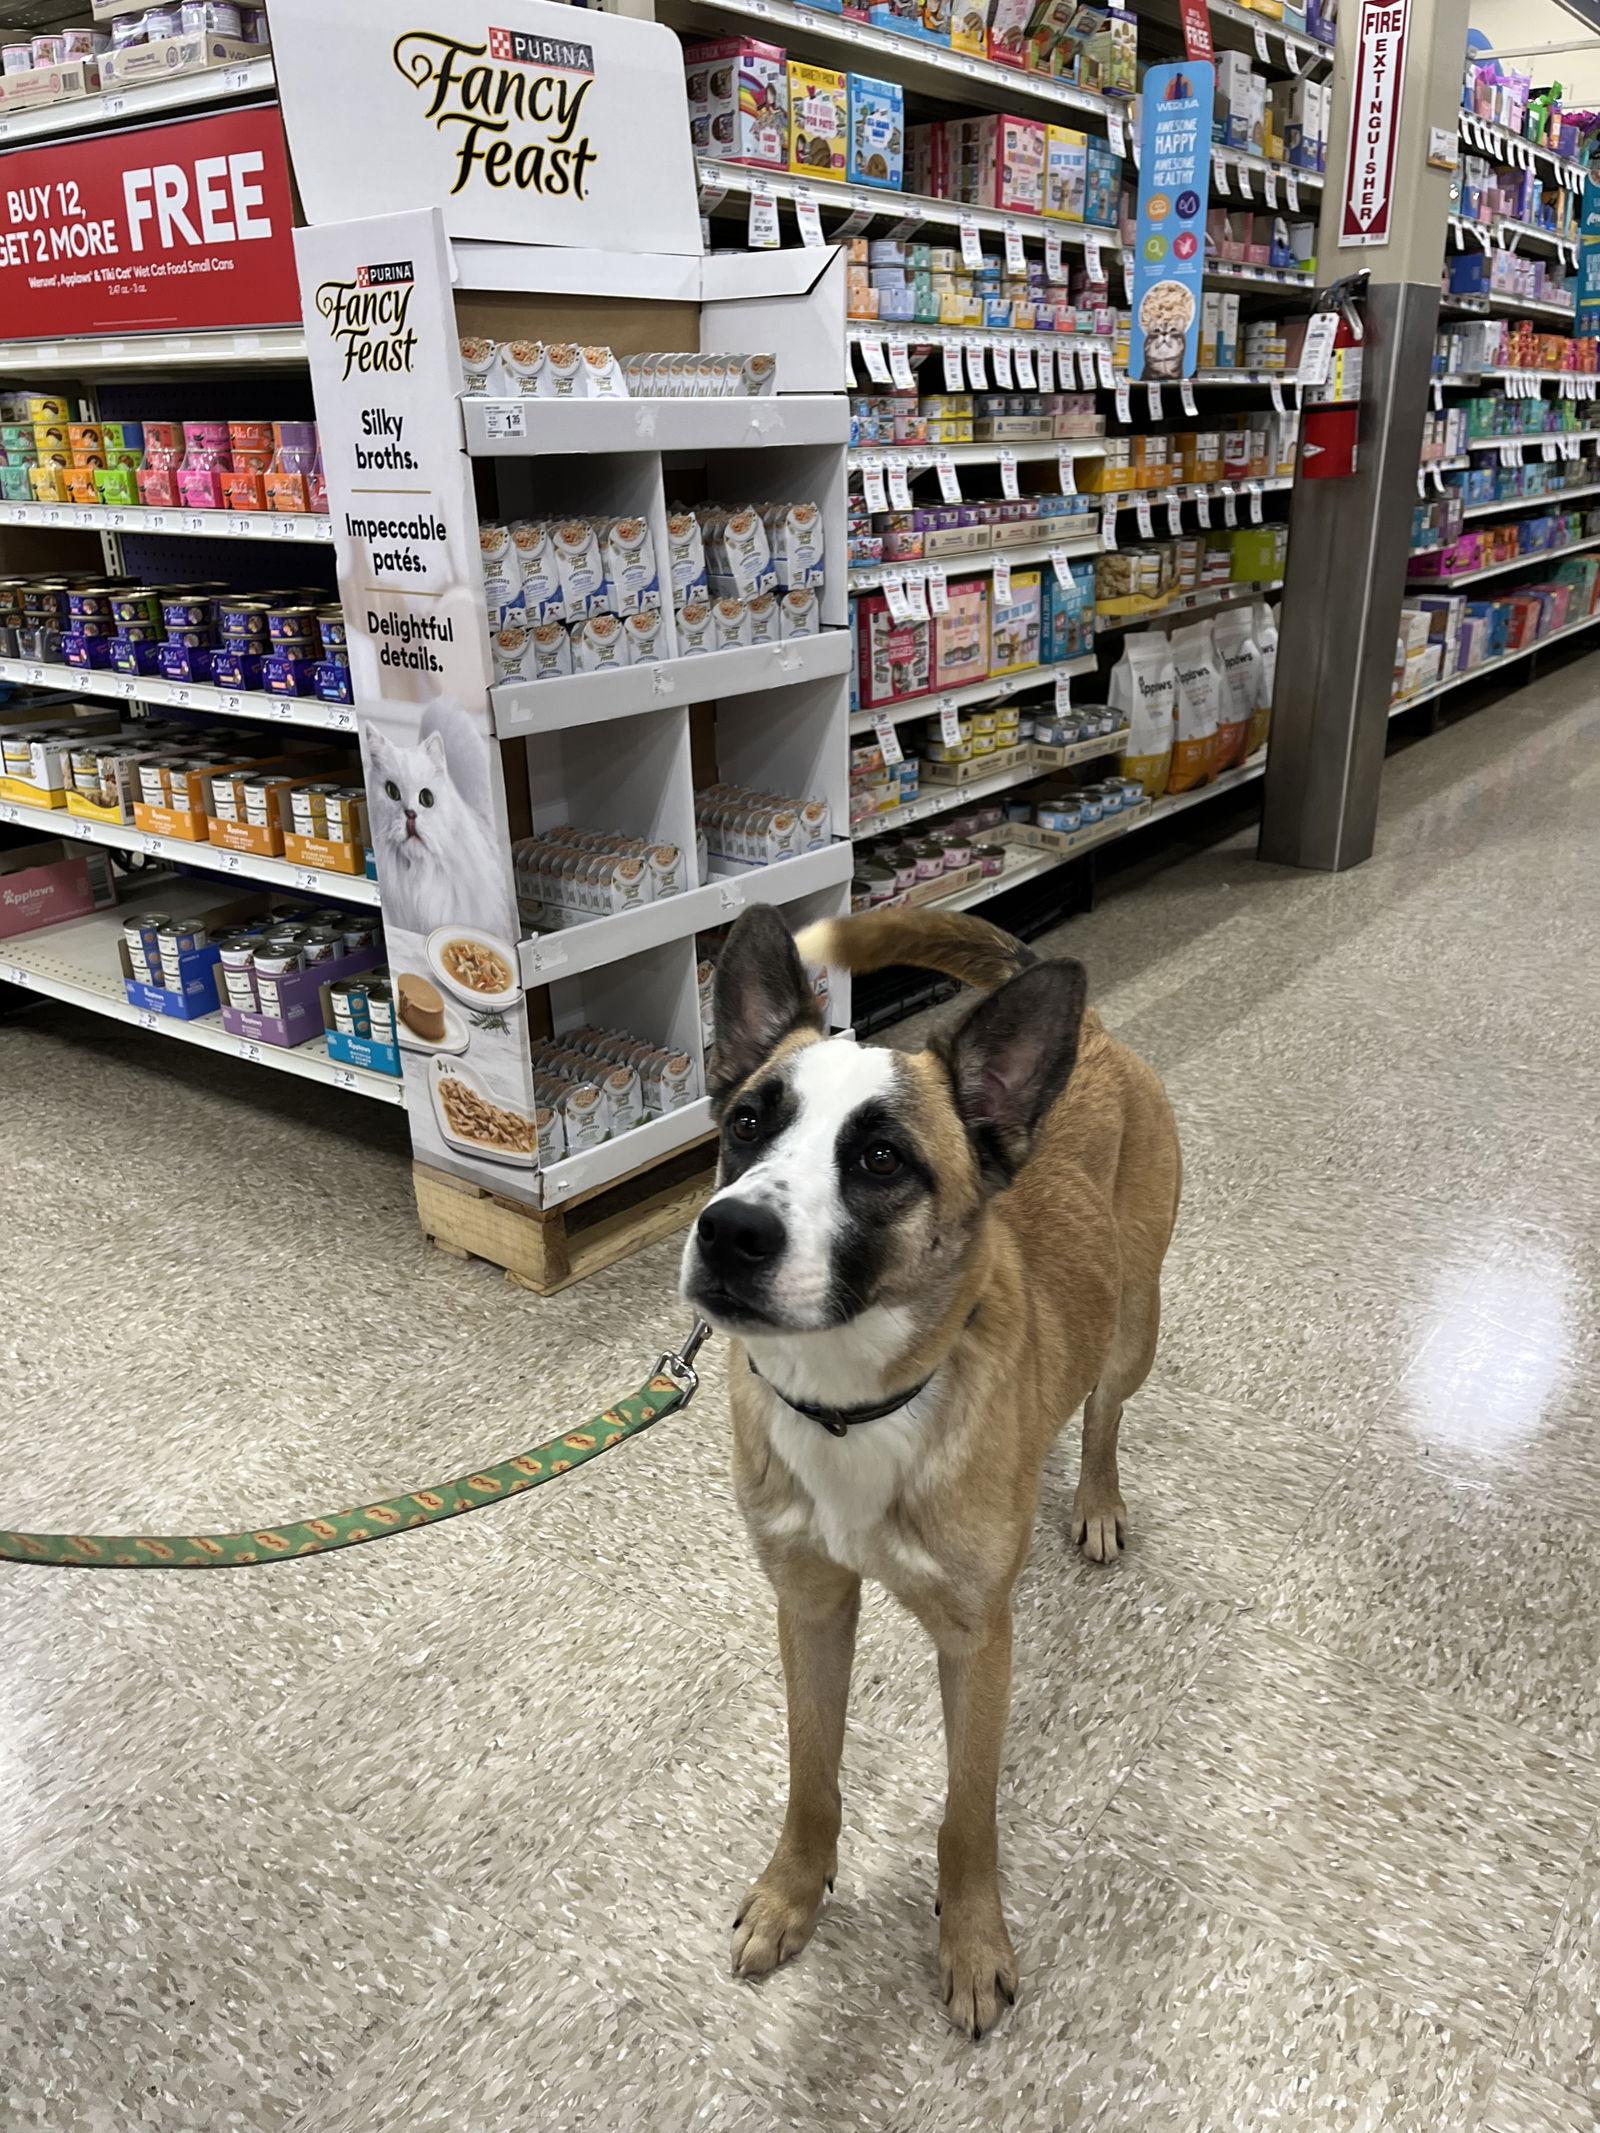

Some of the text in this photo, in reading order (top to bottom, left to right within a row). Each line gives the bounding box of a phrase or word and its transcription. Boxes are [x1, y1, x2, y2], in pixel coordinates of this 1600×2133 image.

[1365, 10, 1402, 35] FIRE
[514, 36, 590, 68] PURINA
[393, 31, 594, 143] Fancy
[1155, 133, 1197, 154] HAPPY
[1360, 39, 1387, 219] EXTINGUISHER
[1153, 170, 1194, 186] HEALTHY
[7, 181, 87, 224] BUY 12,
[122, 150, 273, 253] FREE
[0, 219, 119, 267] GET 2 MORE
[101, 268, 115, 281] Tiki
[133, 265, 150, 278] Wet
[151, 264, 166, 277] Cat
[167, 262, 187, 275] Food
[188, 259, 211, 273] Small
[212, 259, 234, 271] Cans
[370, 265, 412, 281] PURINA
[315, 281, 414, 336] Fancy
[361, 408, 403, 441] Silky
[355, 443, 418, 469] broths.
[345, 513, 447, 543] Impeccable
[373, 547, 427, 575] patés.
[367, 611, 453, 643] Delightful
[380, 643, 443, 673] details.
[3, 885, 54, 905] Applaws
